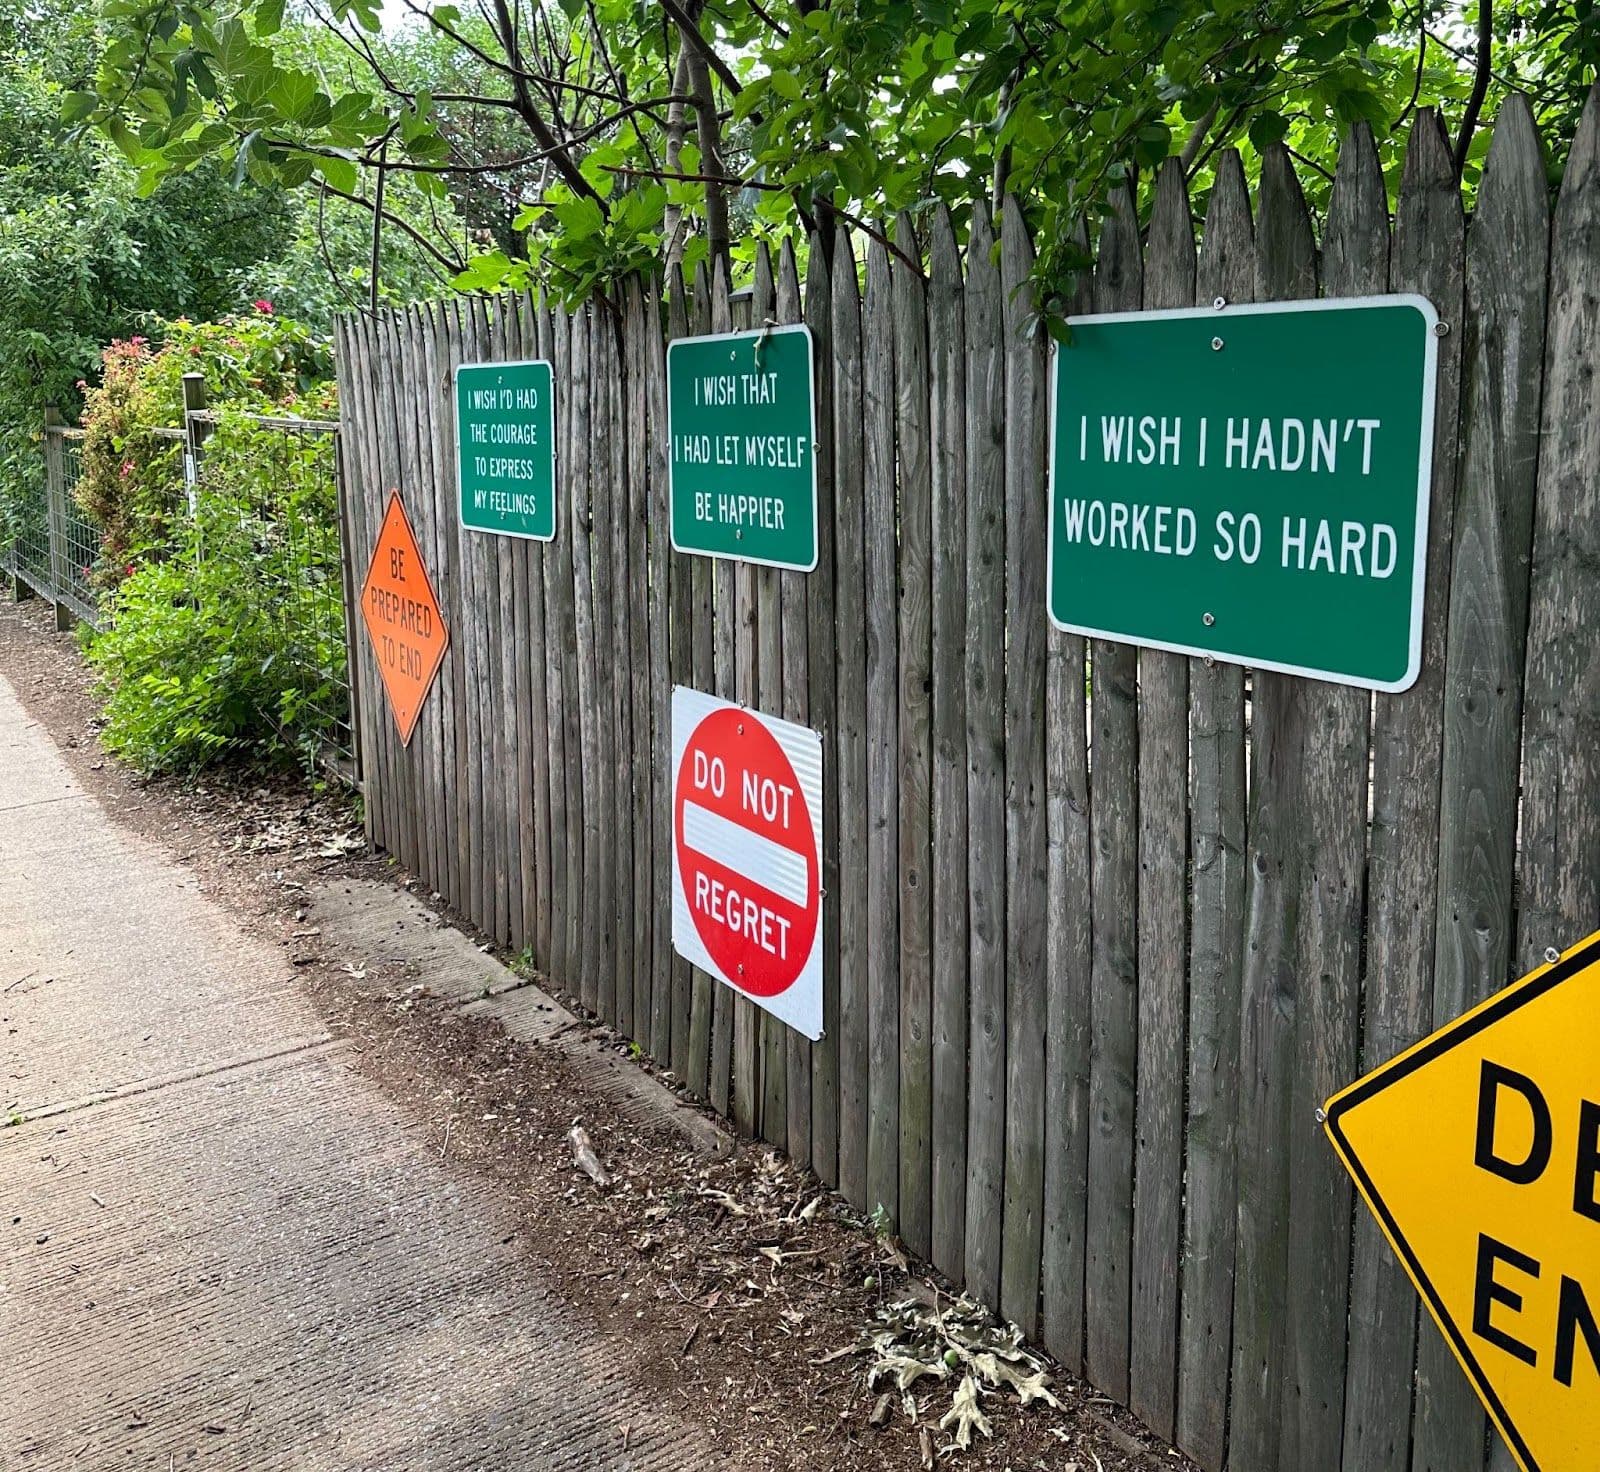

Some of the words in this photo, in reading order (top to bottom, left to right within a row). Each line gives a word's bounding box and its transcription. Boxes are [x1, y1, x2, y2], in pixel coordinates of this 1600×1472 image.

[468, 390, 471, 409] I
[474, 390, 496, 409] WISH
[500, 389, 513, 409] I'D
[516, 389, 538, 409] HAD
[694, 377, 699, 406] I
[703, 375, 736, 405] WISH
[741, 373, 777, 404] THAT
[470, 423, 487, 443] THE
[490, 424, 537, 444] COURAGE
[675, 435, 679, 461] I
[684, 436, 710, 464] HAD
[716, 436, 739, 464] LET
[746, 436, 806, 467] MYSELF
[1080, 415, 1087, 461] I
[1101, 415, 1181, 465] WISH
[1198, 417, 1207, 466] I
[1225, 418, 1381, 475] HADN'T
[475, 457, 487, 476] TO
[490, 458, 533, 480] EXPRESS
[474, 489, 487, 509] MY
[490, 491, 536, 515] FEELINGS
[695, 491, 712, 521] BE
[718, 494, 785, 530] HAPPIER
[1064, 498, 1197, 556] WORKED
[1213, 511, 1262, 564] SO
[1281, 516, 1398, 579] HARD
[390, 547, 406, 581] BE
[371, 586, 431, 638] PREPARED
[382, 635, 395, 667] TO
[400, 643, 422, 681] END
[694, 749, 726, 798] DO
[742, 769, 794, 828] NOT
[695, 870, 791, 960] REGRET
